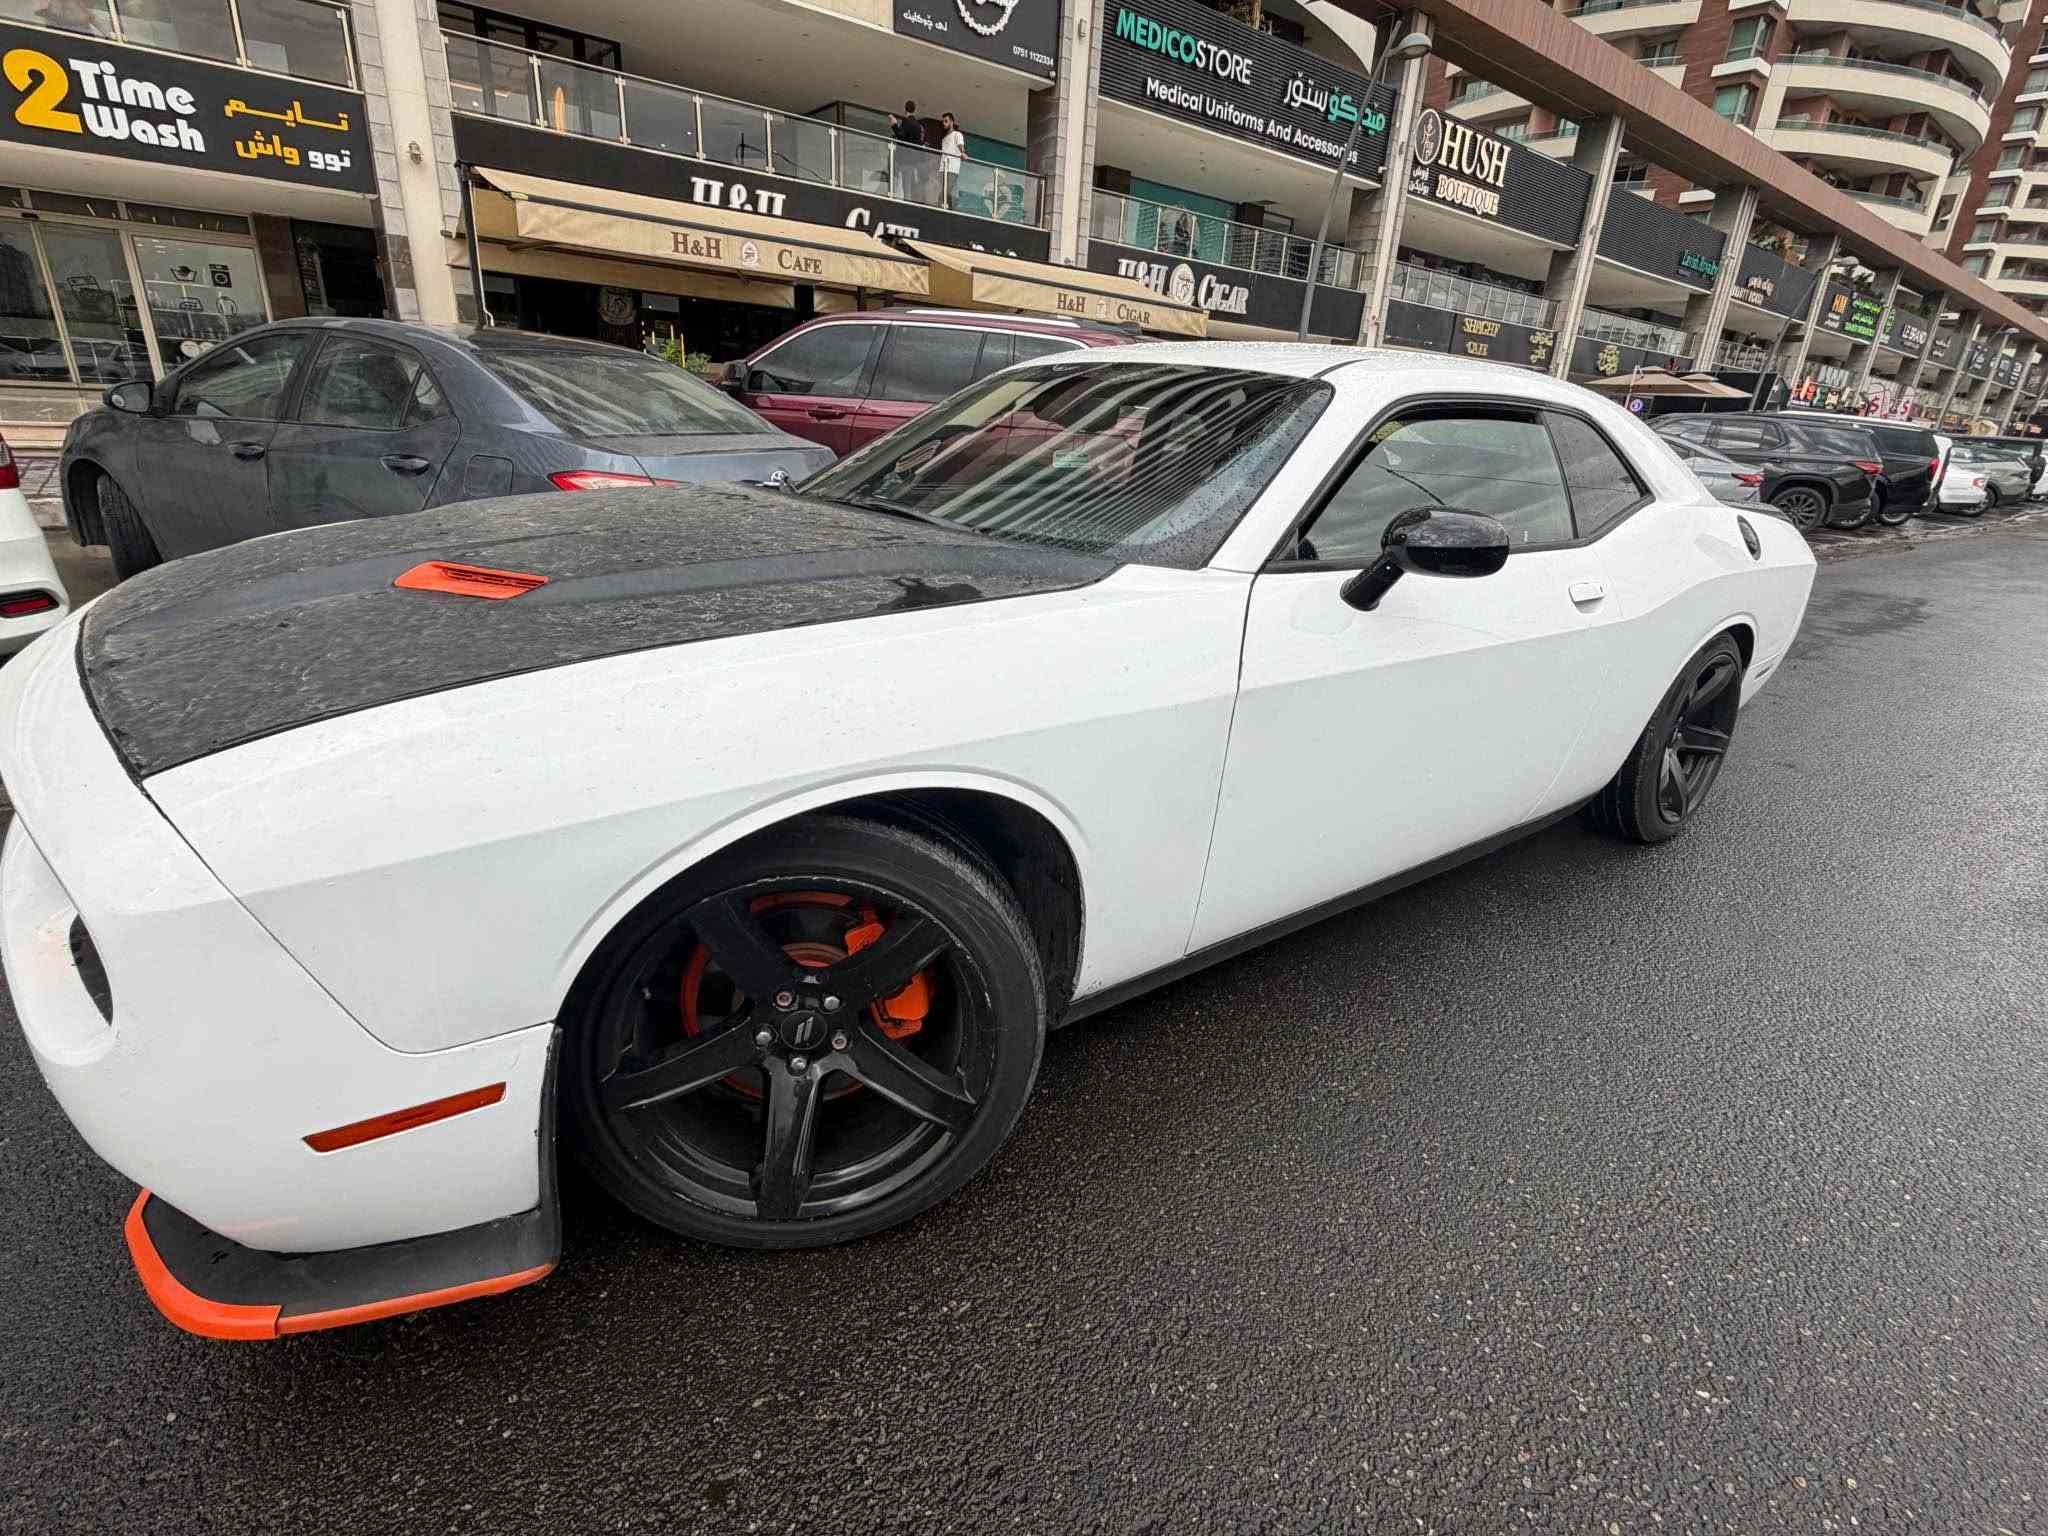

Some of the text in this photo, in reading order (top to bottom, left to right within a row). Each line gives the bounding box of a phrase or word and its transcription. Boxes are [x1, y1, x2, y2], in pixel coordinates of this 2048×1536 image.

[1012, 45, 1028, 59] 0751
[3, 48, 83, 134] 2
[68, 57, 197, 115] Time
[81, 102, 206, 153] Wash
[1146, 77, 1358, 163] Medical Uniforms And Accessors
[1438, 120, 1512, 188] HUSH
[1436, 174, 1500, 216] BOUTIQUE
[671, 231, 721, 260] H&H
[1056, 292, 1087, 313] H&H
